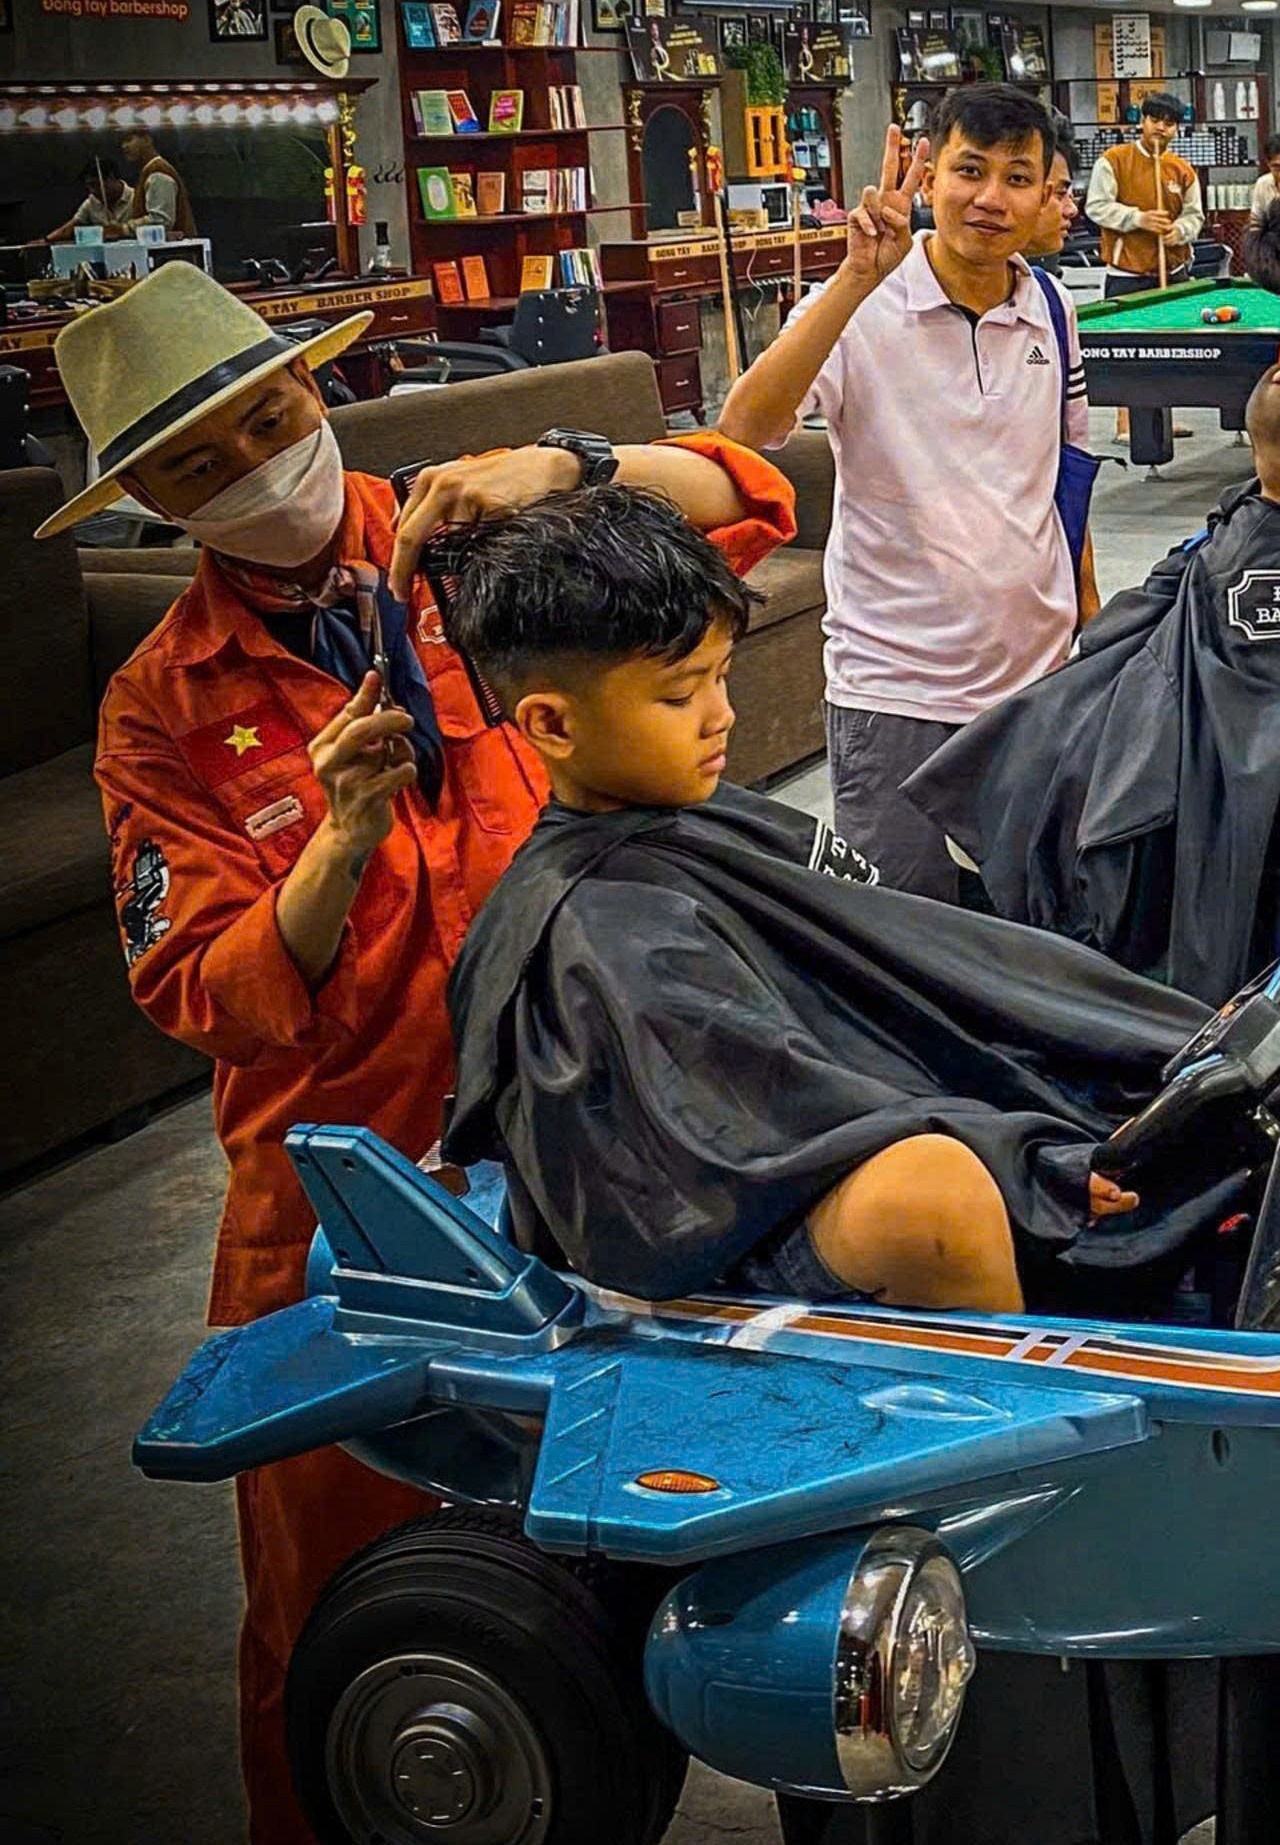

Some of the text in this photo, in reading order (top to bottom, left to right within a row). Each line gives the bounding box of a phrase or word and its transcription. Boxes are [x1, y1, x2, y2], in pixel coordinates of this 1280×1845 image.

[110, 0, 188, 18] barbershop
[317, 291, 373, 308] BARBER
[375, 287, 411, 299] SHOP
[1081, 348, 1110, 359] ONG
[1138, 348, 1221, 359] BARBERSHOP
